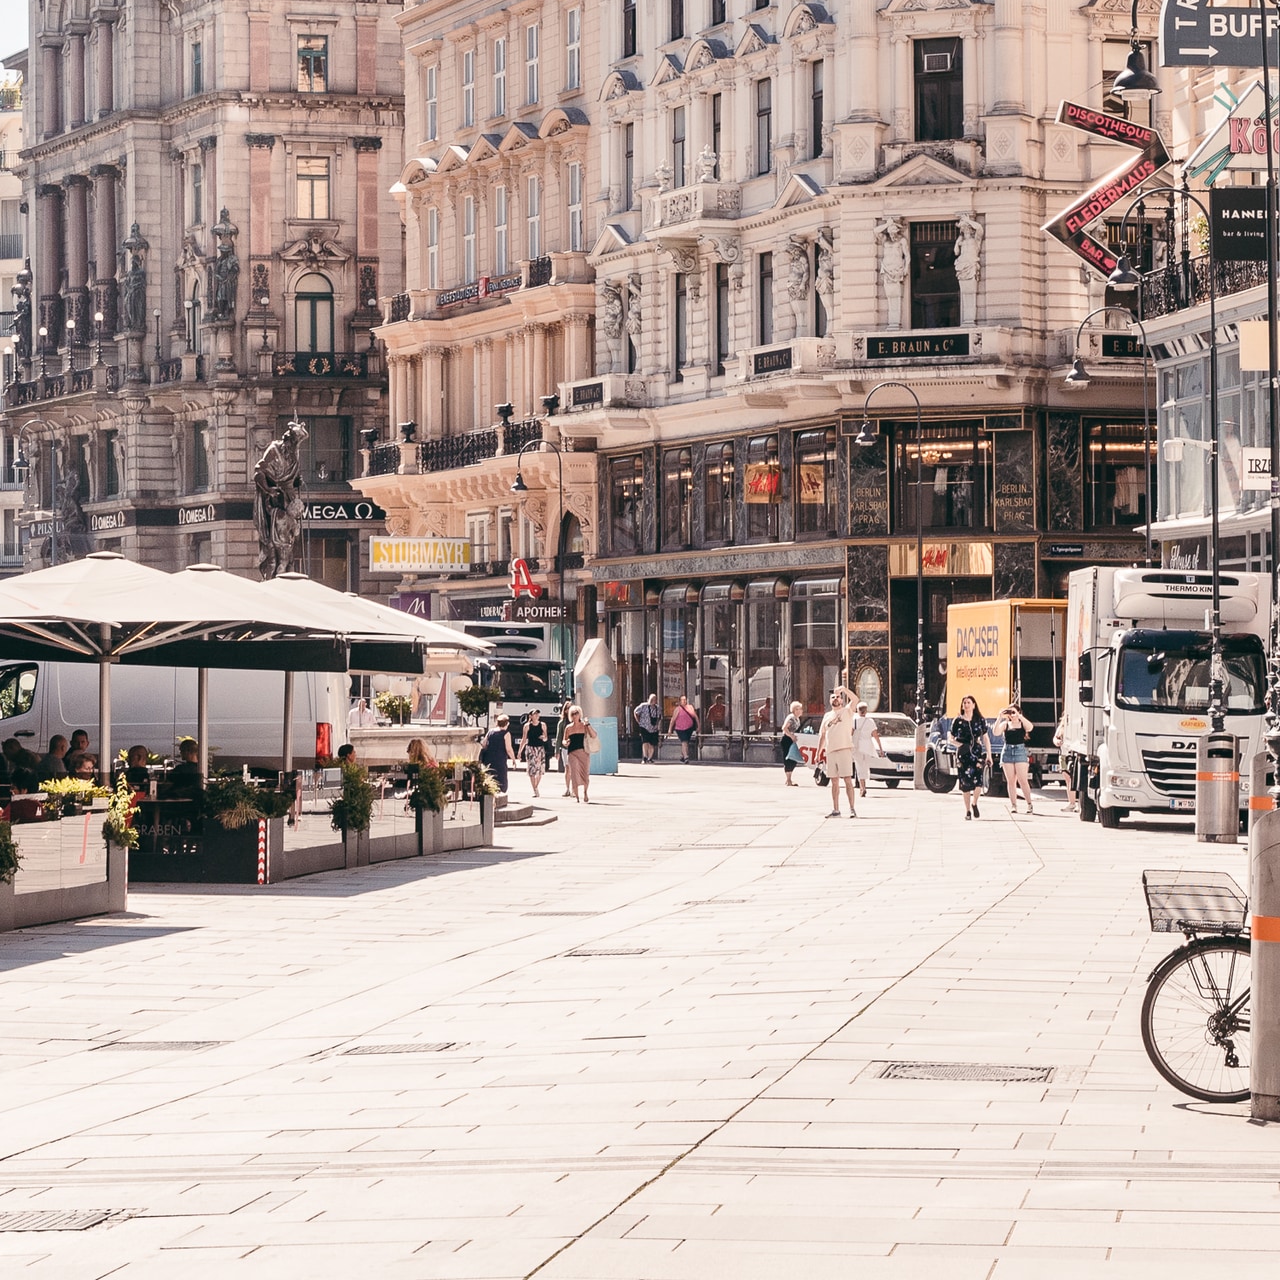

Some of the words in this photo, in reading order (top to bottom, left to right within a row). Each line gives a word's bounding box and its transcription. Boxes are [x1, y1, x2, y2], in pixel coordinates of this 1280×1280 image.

[1067, 105, 1152, 142] DISCOTHEQUE
[1065, 160, 1156, 233] FLEDERMAUS
[1080, 239, 1104, 260] BAR
[878, 342, 888, 354] E.
[892, 339, 931, 353] BRAUN
[856, 488, 881, 497] BERLIN
[1002, 484, 1027, 494] BERLIN
[850, 501, 887, 510] KARLSBAD
[995, 498, 1033, 507] KARLSBAD
[186, 506, 207, 523] OMEGA
[302, 504, 349, 519] MEGA
[859, 514, 880, 523] PRAG
[1004, 511, 1025, 520] PRAG
[98, 515, 117, 530] OMEGA
[379, 542, 464, 564] STURMAYR
[1170, 545, 1192, 570] House
[1165, 584, 1198, 593] THERMO
[957, 625, 999, 658] DACHSER
[956, 665, 978, 680] Intelligent
[1171, 741, 1197, 749] DA
[133, 824, 182, 835] GRABEN
